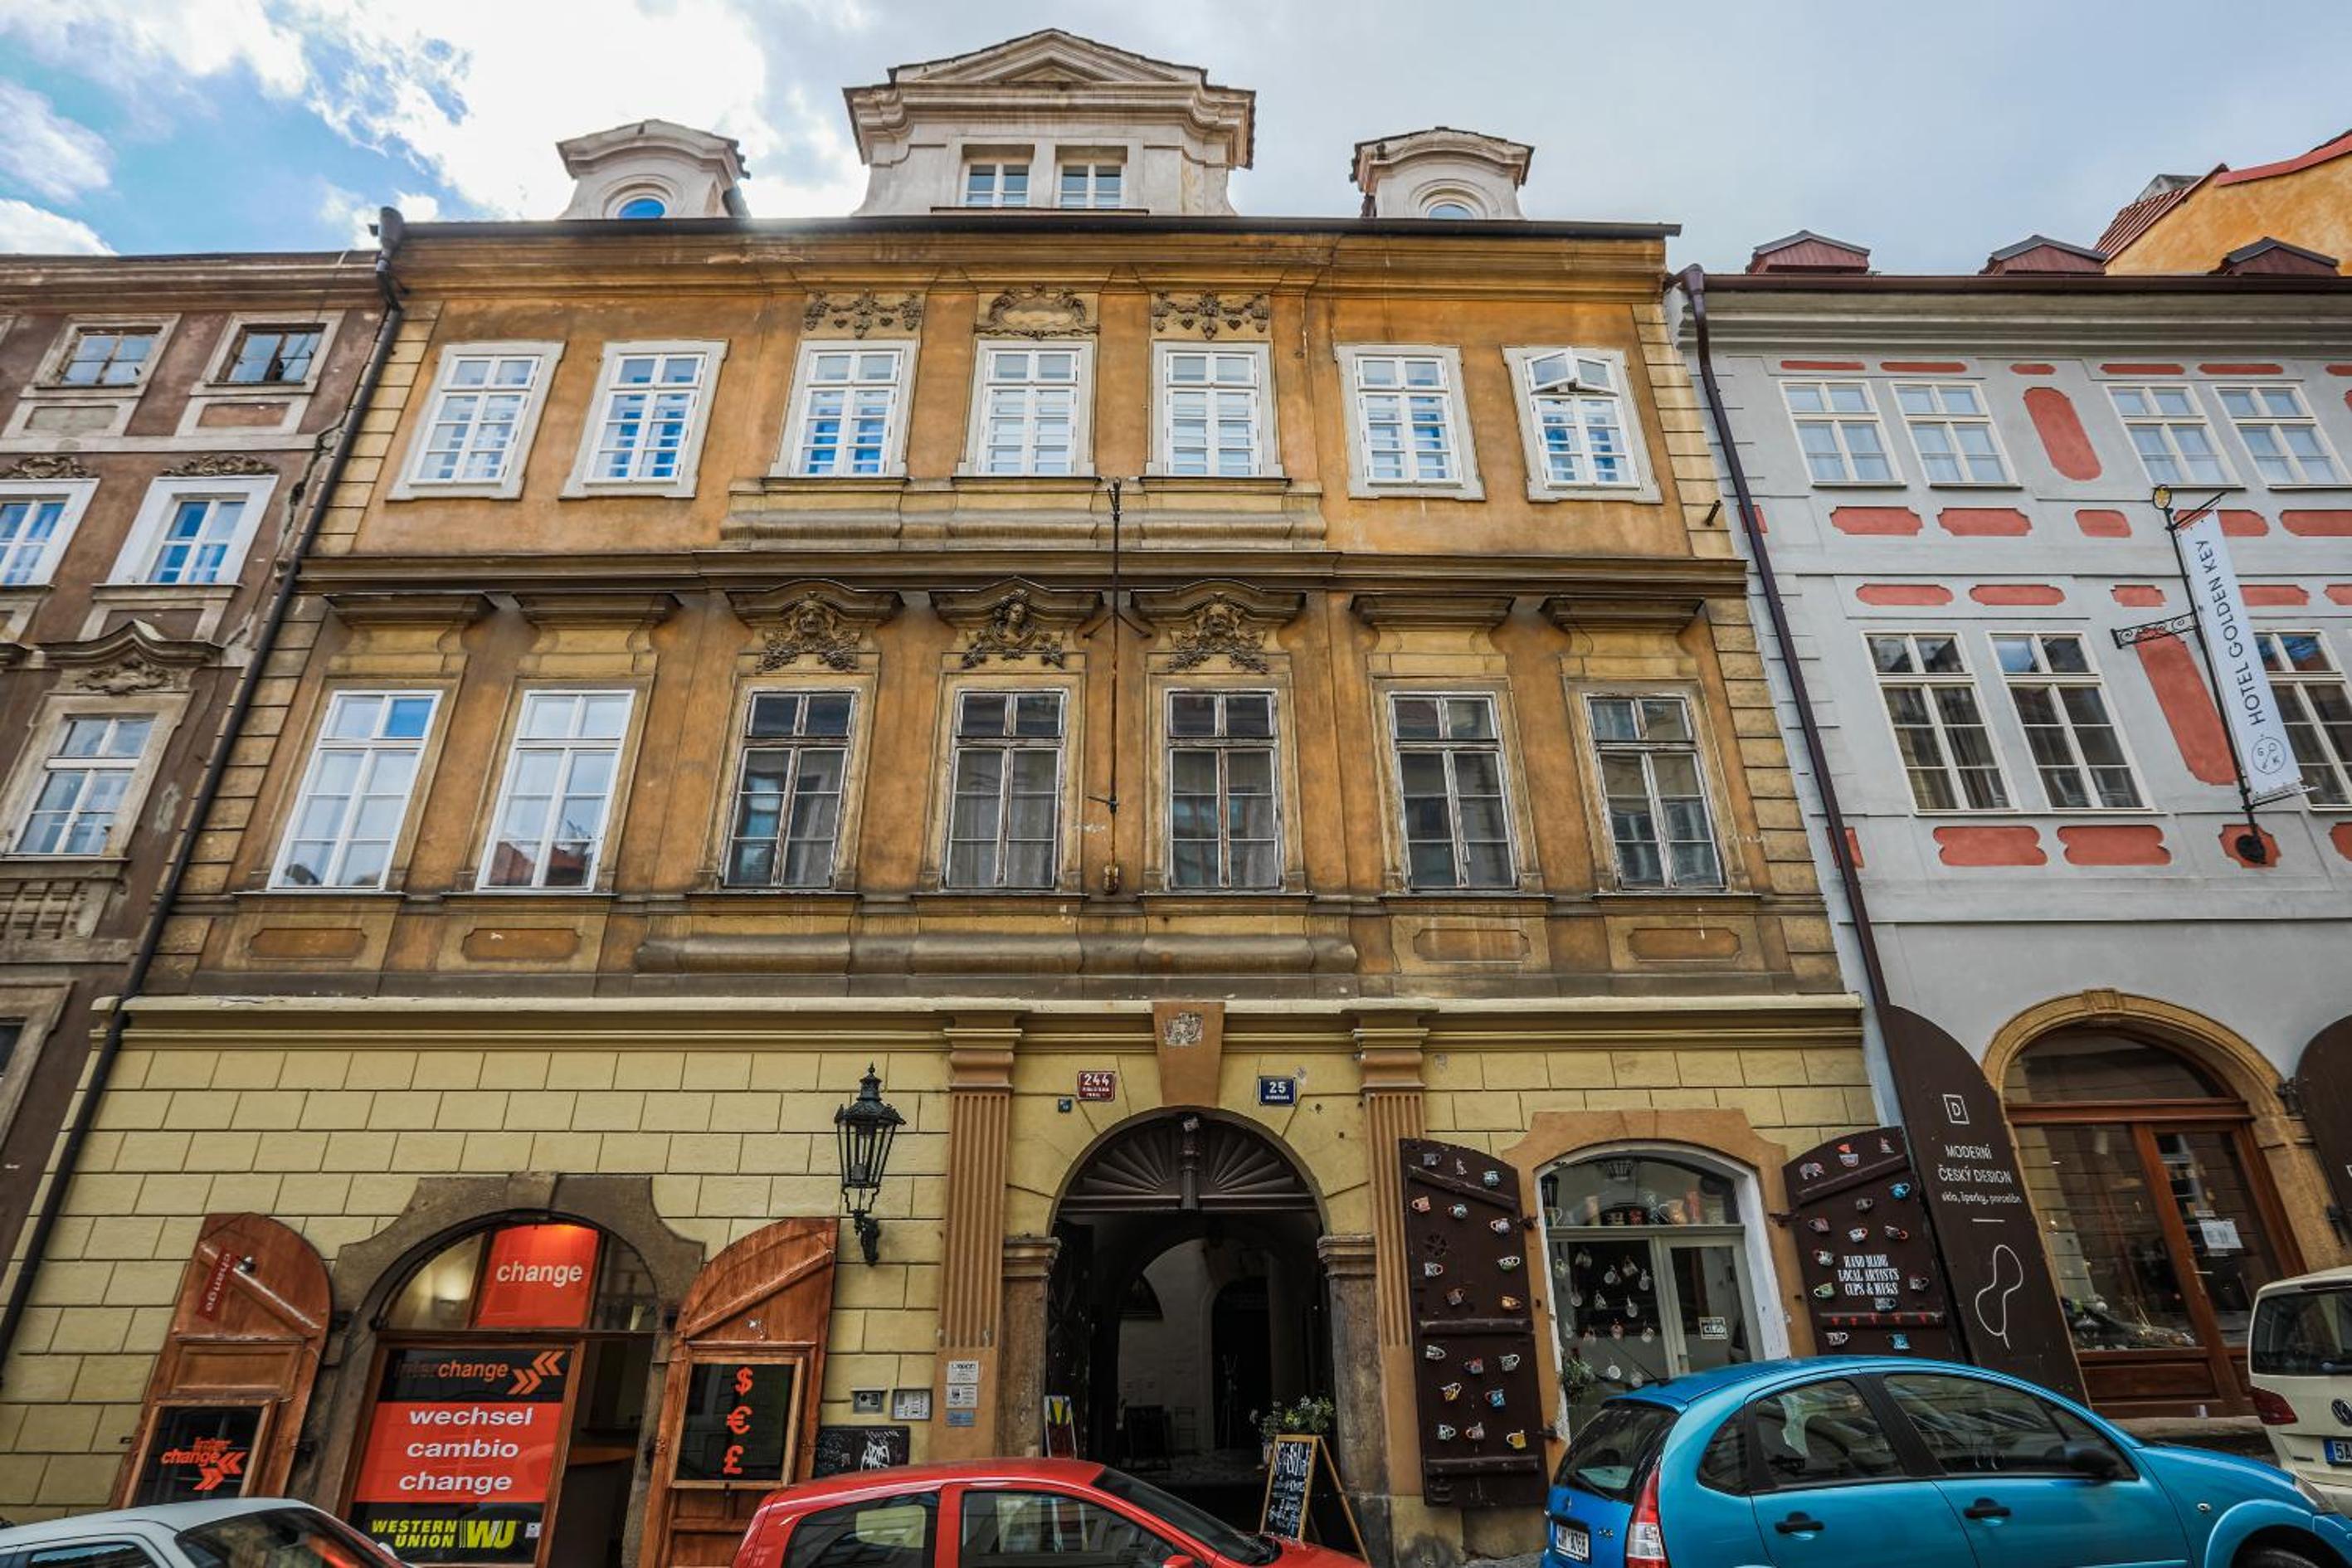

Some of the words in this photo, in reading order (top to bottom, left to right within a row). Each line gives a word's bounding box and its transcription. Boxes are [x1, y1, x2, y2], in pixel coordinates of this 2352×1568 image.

[2195, 540, 2218, 573] KEY
[2208, 577, 2243, 658] GOLDEN
[2235, 661, 2266, 726] HOTEL
[1083, 1074, 1110, 1086] 244
[1269, 1081, 1286, 1093] 25
[1950, 1102, 1960, 1116] D
[1938, 1164, 1971, 1181] ČESKÝ
[1973, 1169, 2012, 1183] DESIGN
[1843, 1255, 1865, 1268] HAND
[1865, 1254, 1888, 1267] MADE
[206, 1254, 231, 1312] change
[496, 1260, 582, 1288] change
[1837, 1269, 1863, 1282] LOCAL
[1864, 1268, 1900, 1281] ARTISTS
[1845, 1283, 1865, 1296] CUPS
[1867, 1283, 1874, 1295] &
[1874, 1282, 1899, 1294] MUGS
[409, 1406, 533, 1425] wechsel
[407, 1439, 519, 1458] cambio
[161, 1449, 221, 1468] change
[399, 1472, 514, 1495] change
[371, 1519, 457, 1533] WESTERN
[466, 1520, 517, 1550] WU
[394, 1534, 455, 1548] UNION
